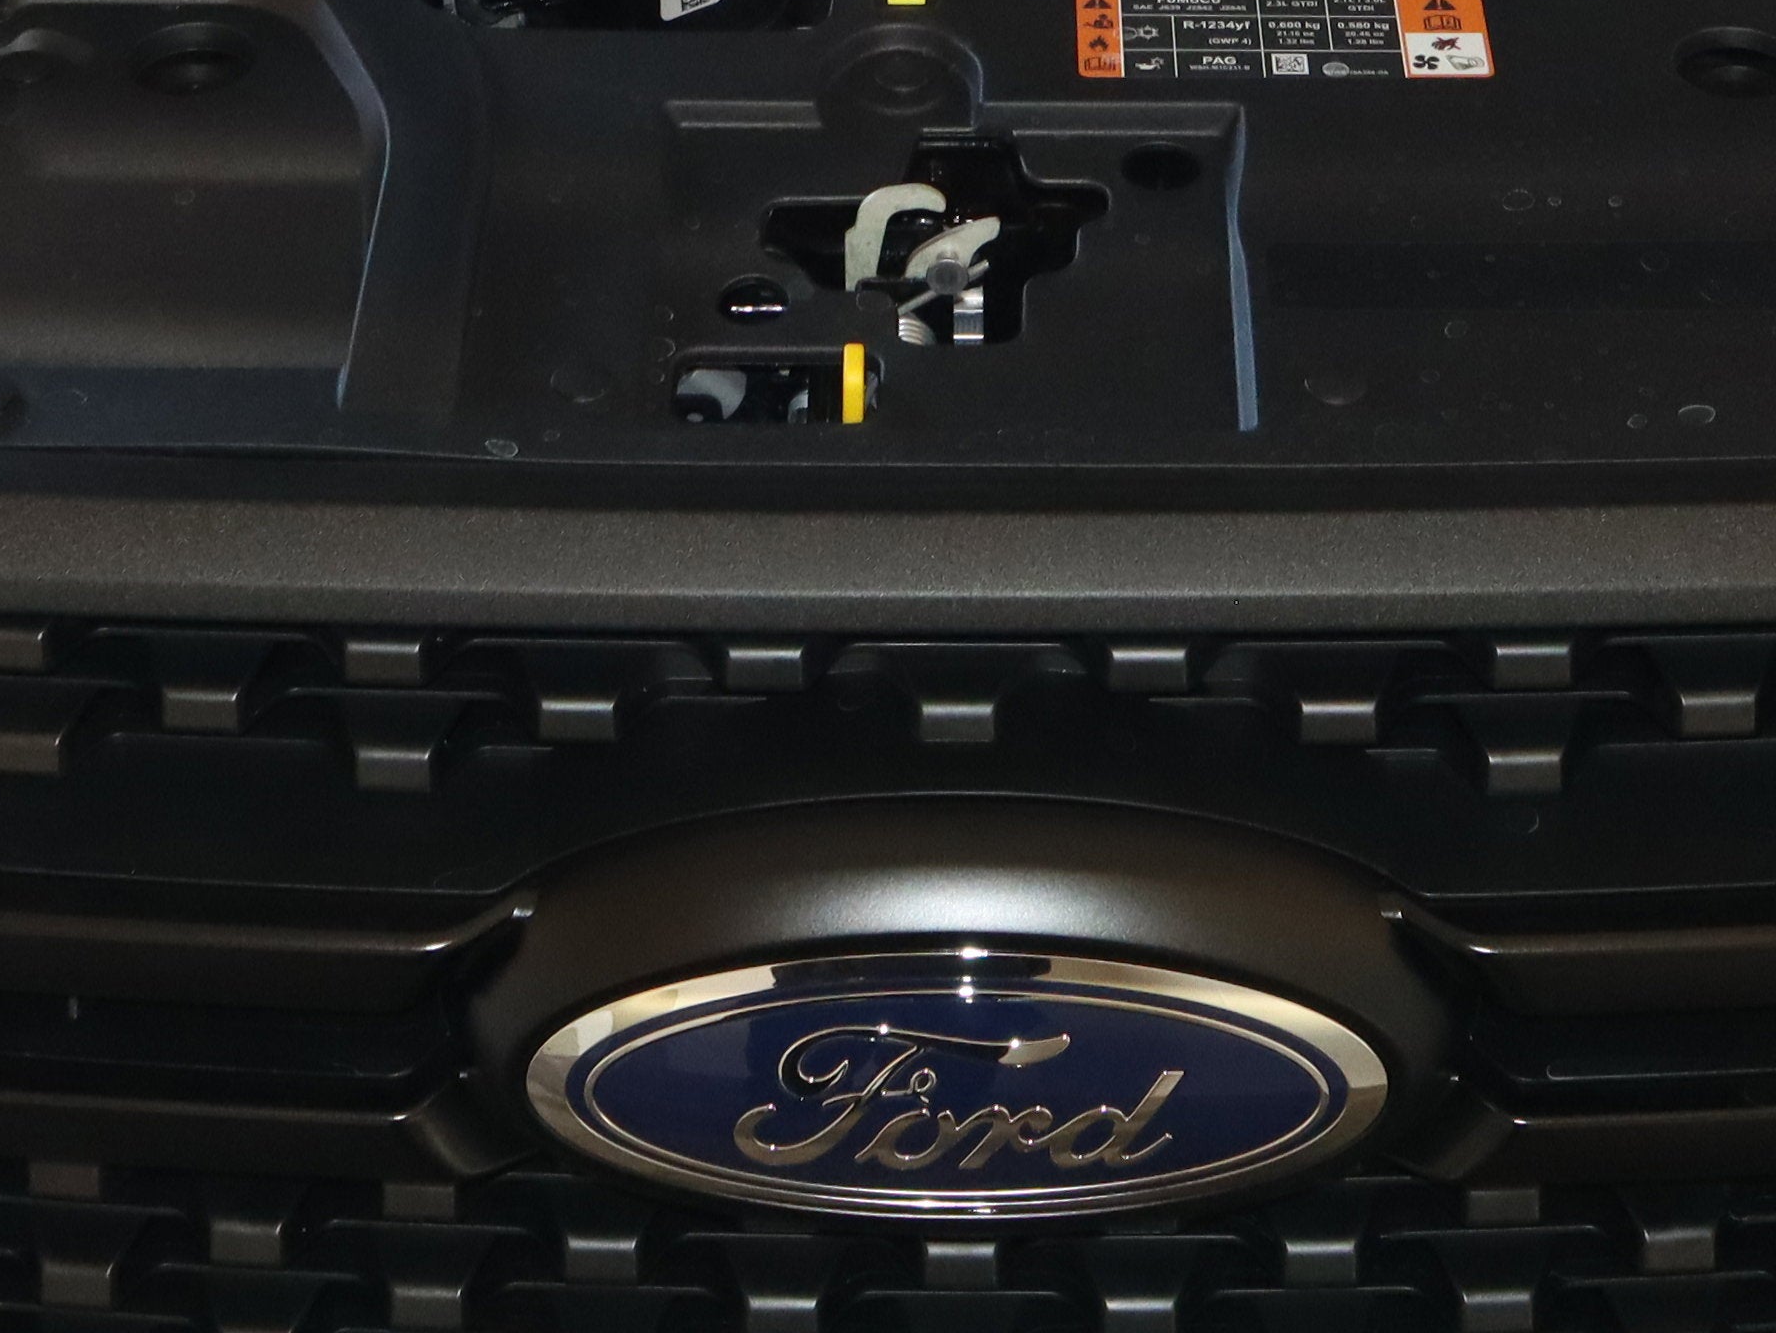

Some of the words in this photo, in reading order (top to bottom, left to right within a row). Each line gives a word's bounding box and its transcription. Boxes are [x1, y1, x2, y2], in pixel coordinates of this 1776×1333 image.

[1183, 21, 1251, 31] R-1234yf
[1305, 21, 1320, 30] kg
[1374, 22, 1390, 30] kg
[1203, 56, 1237, 64] PAG
[733, 1025, 1186, 1171] Ford
